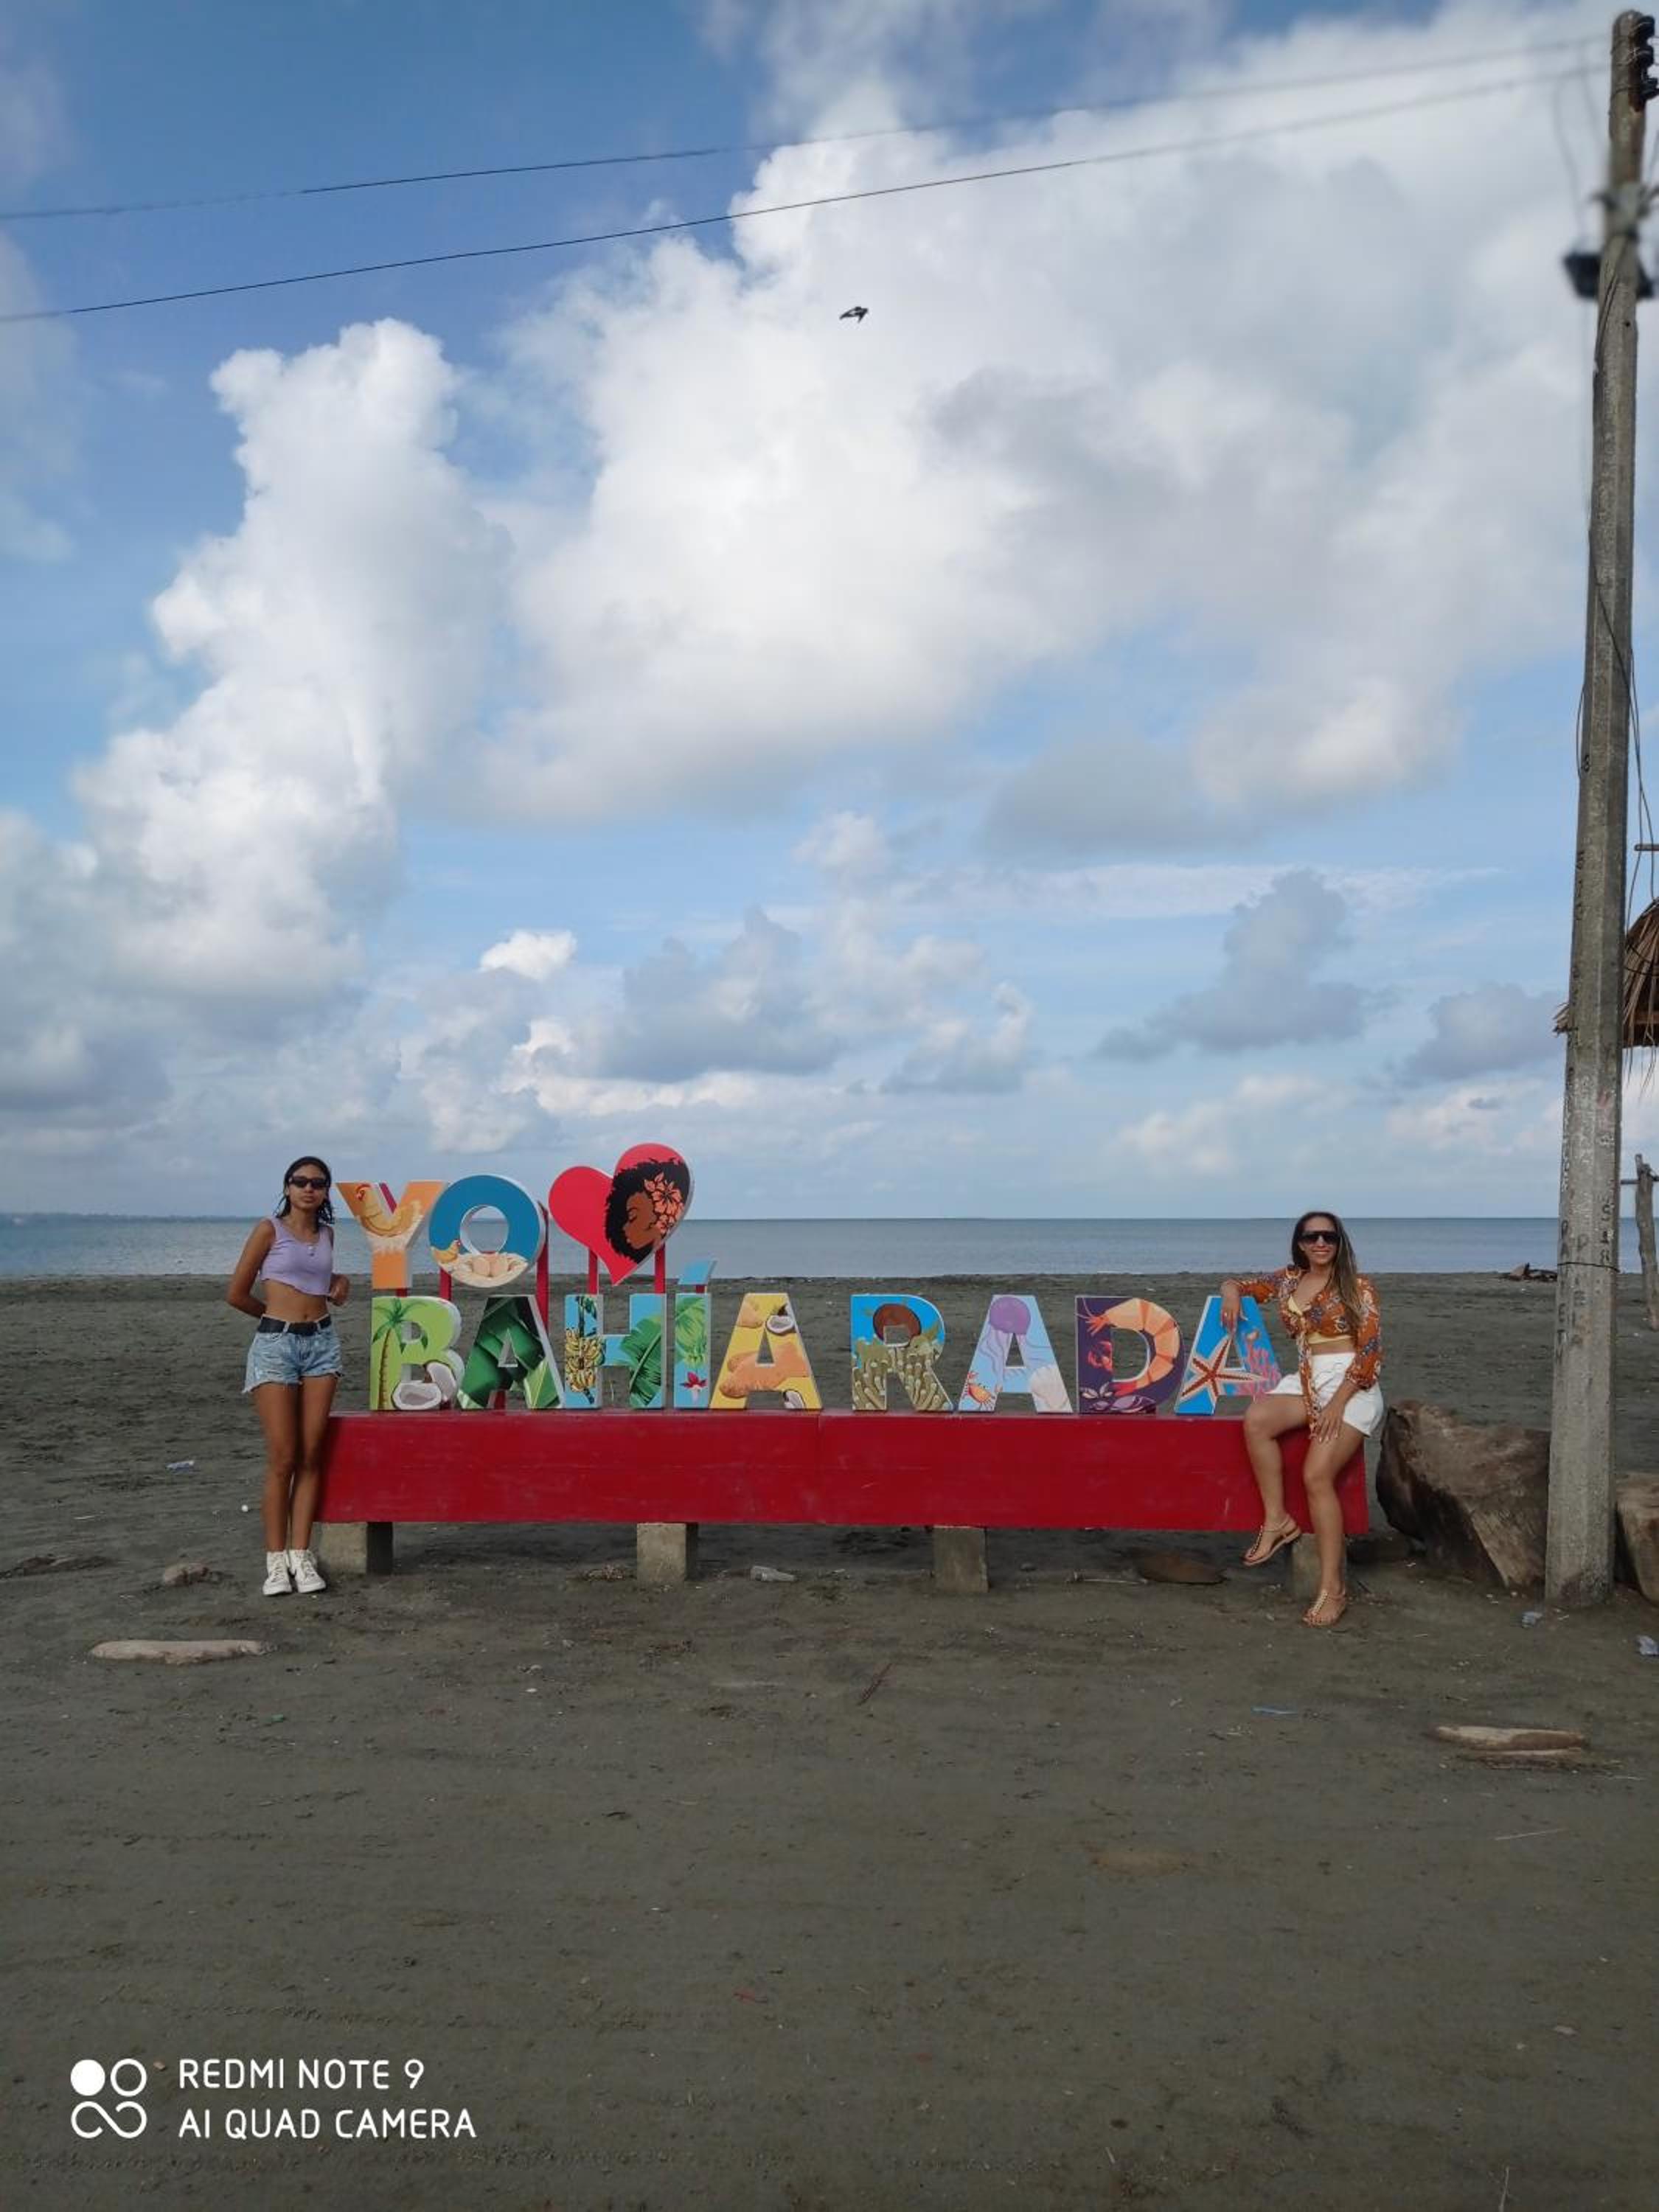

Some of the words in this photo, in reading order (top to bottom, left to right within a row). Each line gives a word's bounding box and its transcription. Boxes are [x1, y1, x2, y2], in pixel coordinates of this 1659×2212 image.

[336, 1174, 547, 1288] YO
[371, 1260, 823, 1410] BAHÍA
[850, 1294, 1282, 1416] RADA
